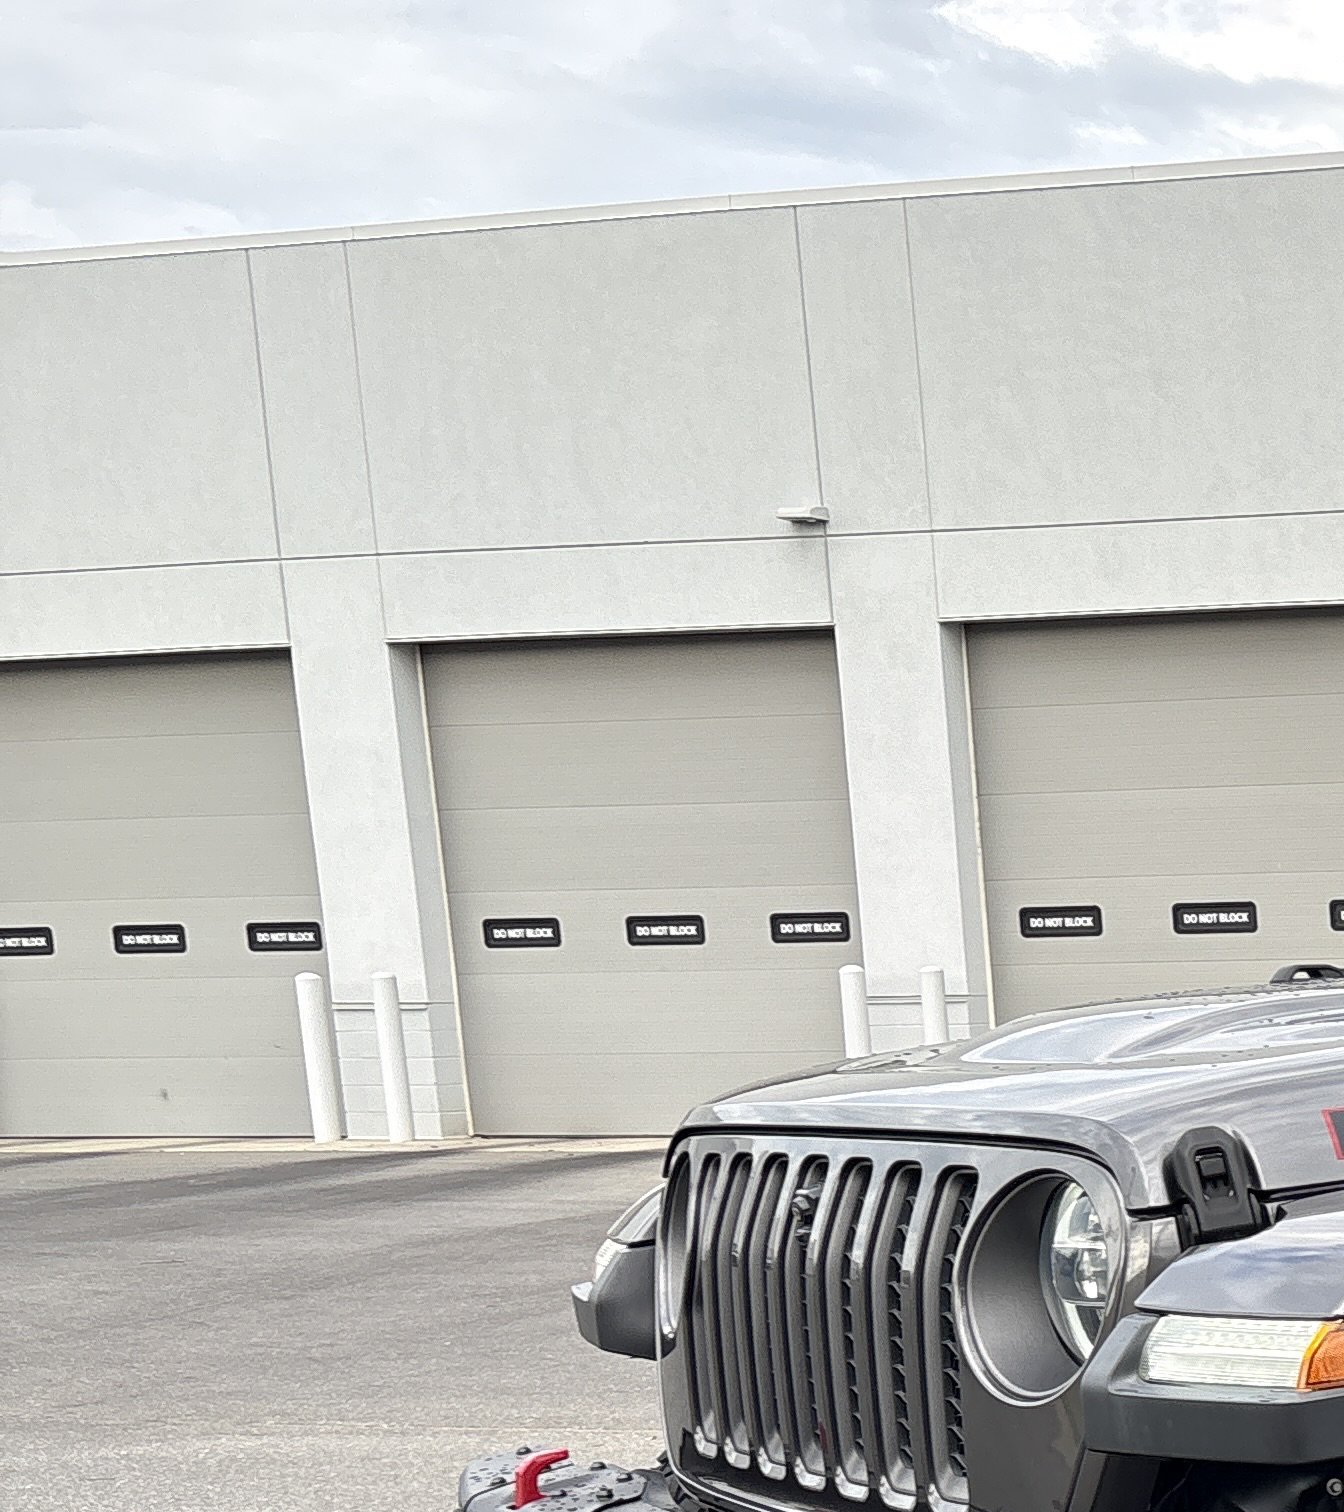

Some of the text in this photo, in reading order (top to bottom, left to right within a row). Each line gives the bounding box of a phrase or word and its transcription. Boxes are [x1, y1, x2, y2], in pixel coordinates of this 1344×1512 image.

[1030, 916, 1094, 927] DO NOT BLOCK
[1183, 912, 1249, 923] DO NOT BLOCK
[493, 928, 554, 938] DO NOT BLOCK
[635, 925, 698, 936] DO NOT BLOCK
[780, 922, 843, 933] DO NOT BLOCK
[122, 934, 179, 944] DO NOT BLOCK
[256, 931, 316, 942] DO NOT BLOCK
